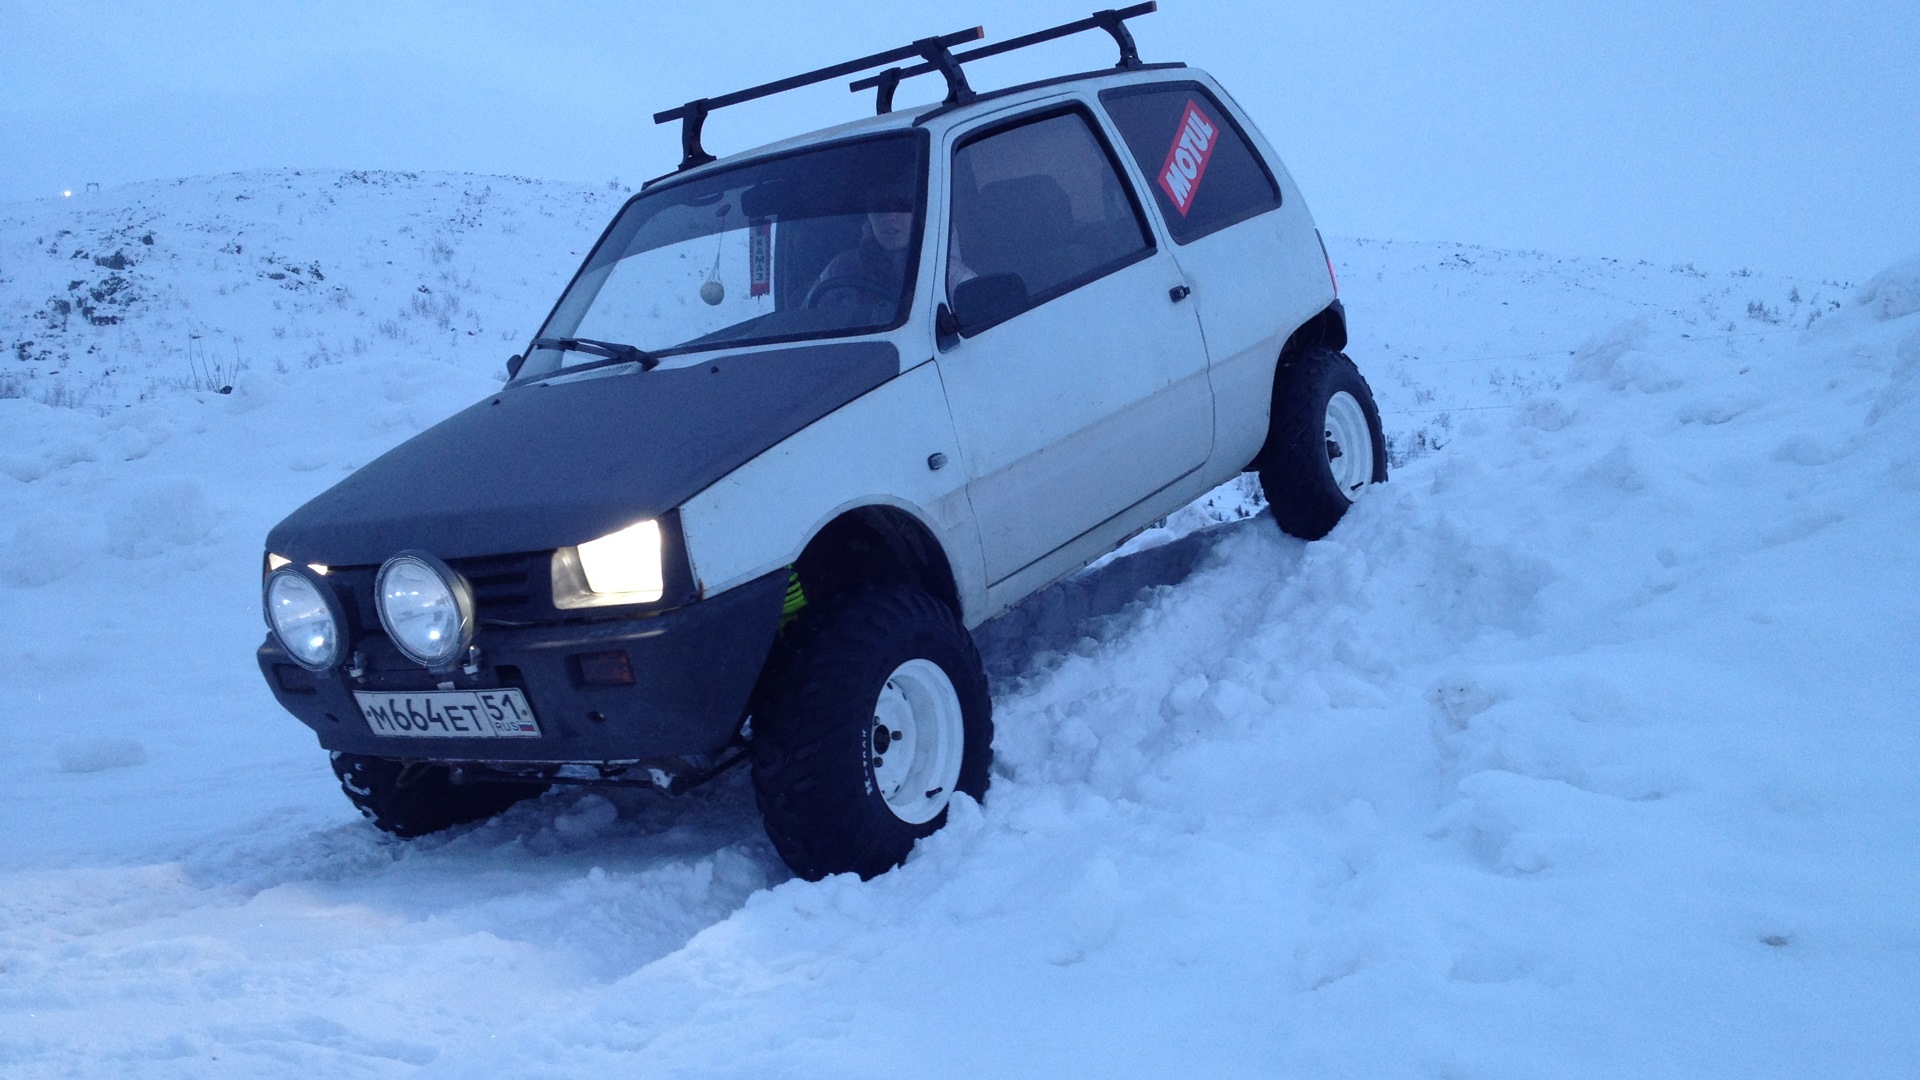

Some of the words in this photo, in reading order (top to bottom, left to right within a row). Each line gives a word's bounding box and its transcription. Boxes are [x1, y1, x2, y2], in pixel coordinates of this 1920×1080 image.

[1165, 110, 1213, 207] MOTUL
[369, 699, 483, 731] М664ЕТ
[482, 695, 522, 721] 51
[496, 722, 519, 731] RUS
